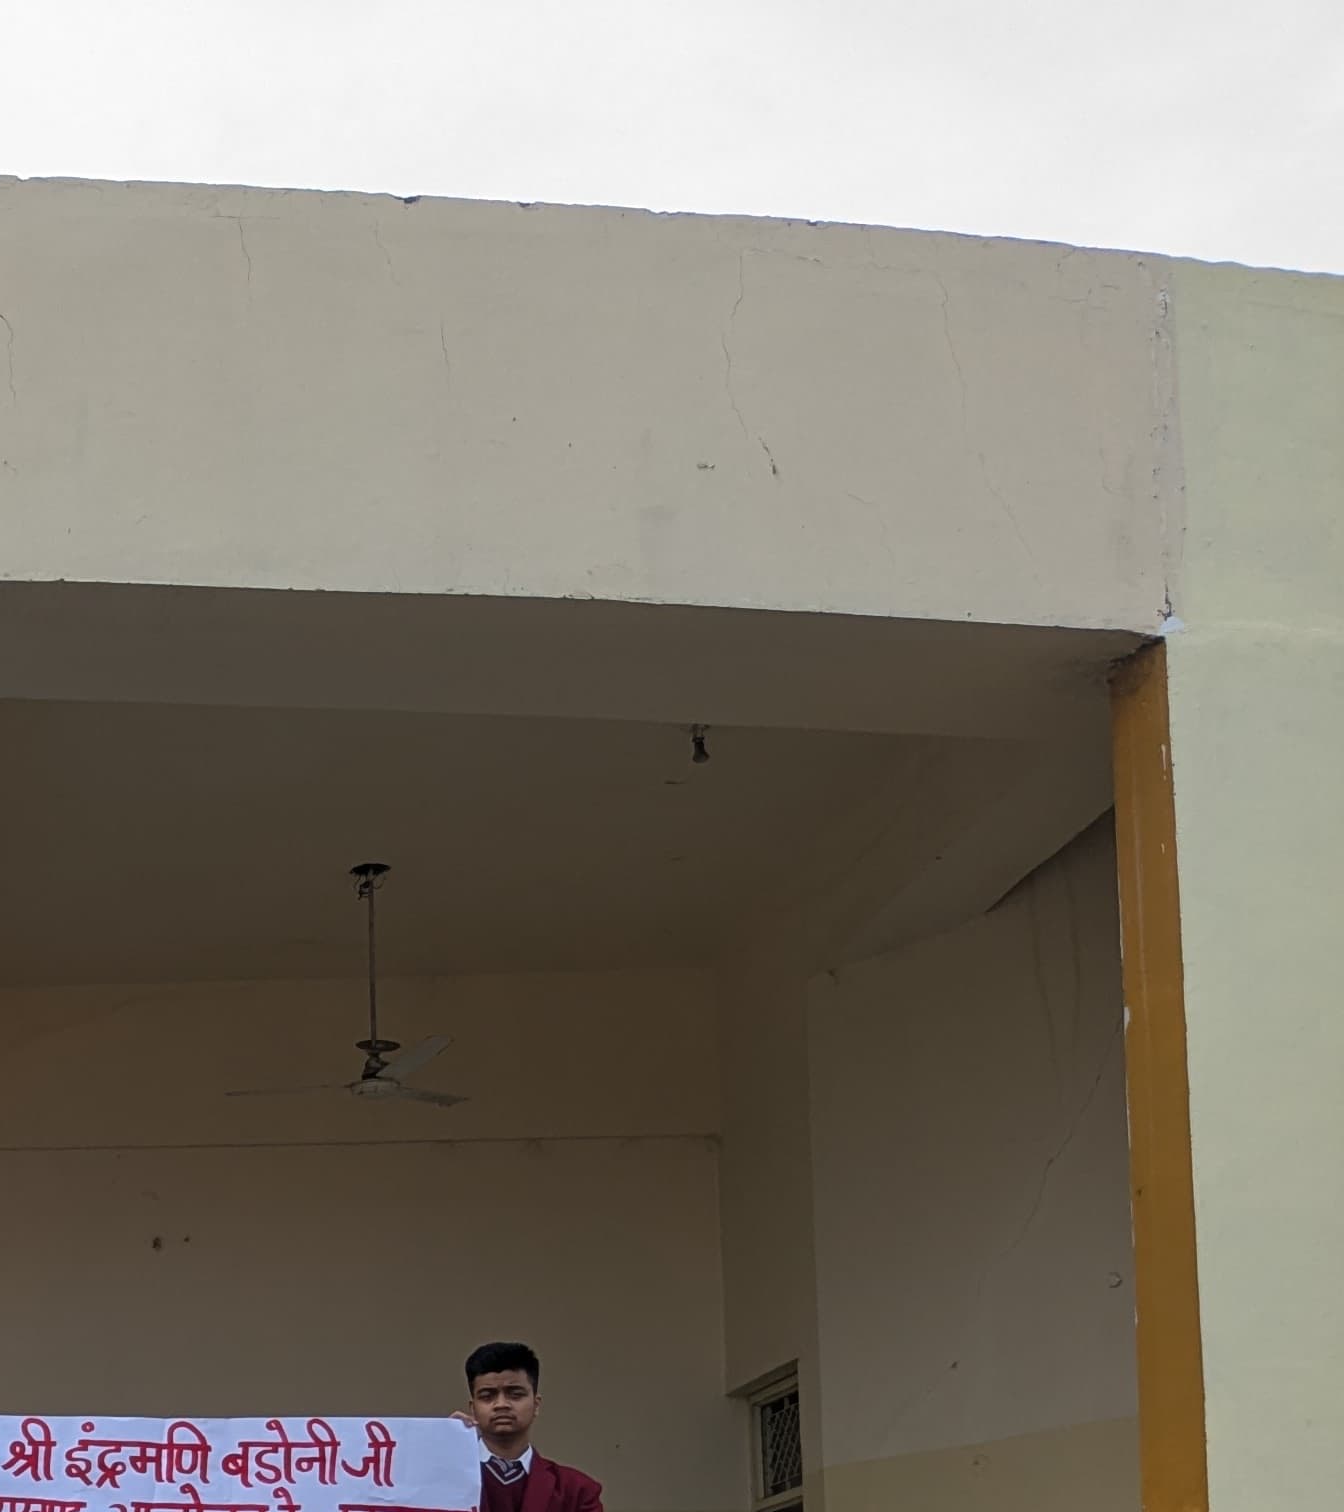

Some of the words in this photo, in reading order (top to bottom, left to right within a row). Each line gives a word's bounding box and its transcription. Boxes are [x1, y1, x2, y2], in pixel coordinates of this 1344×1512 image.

[1, 1418, 56, 1481] श्री
[64, 1421, 211, 1488] इंद्रमणि
[222, 1418, 341, 1487] बडोनी
[341, 1420, 396, 1487] जी
